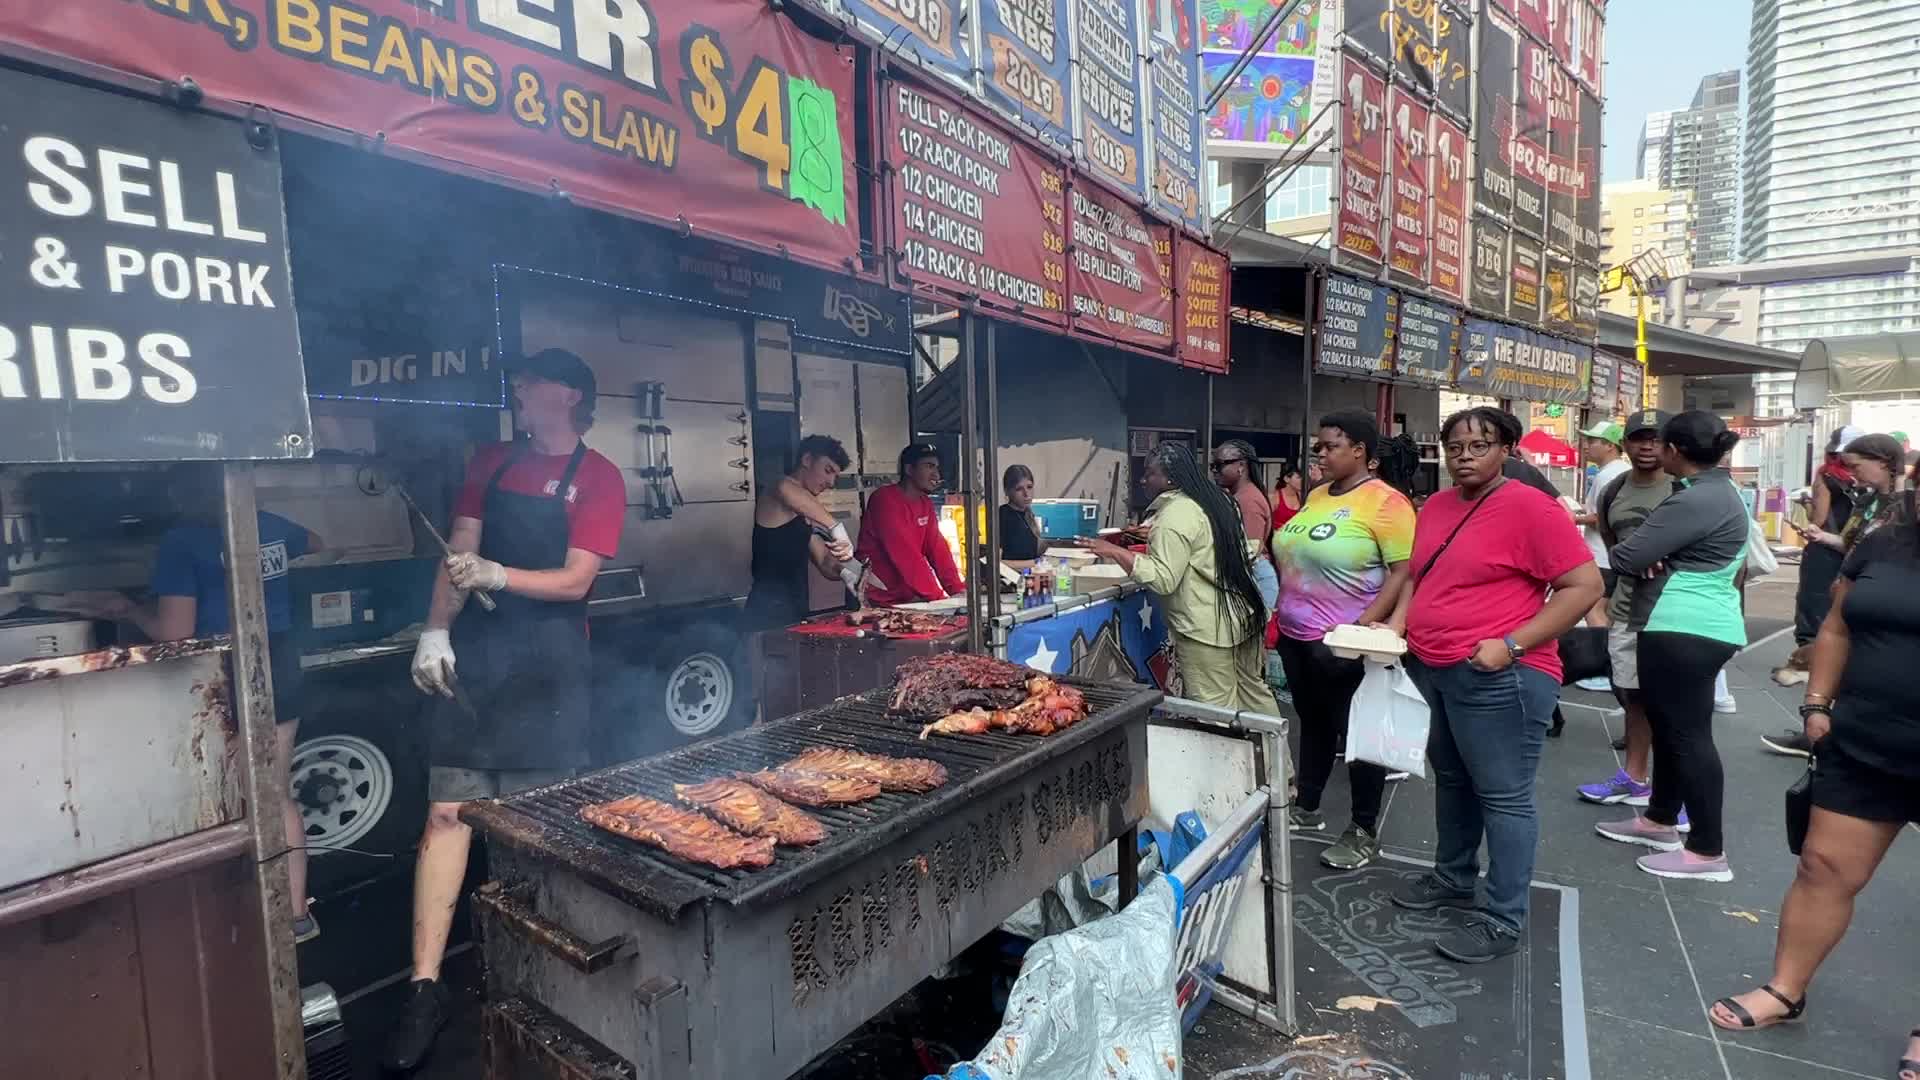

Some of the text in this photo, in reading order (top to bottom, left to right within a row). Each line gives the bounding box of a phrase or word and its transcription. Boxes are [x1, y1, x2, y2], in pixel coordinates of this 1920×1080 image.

[412, 0, 657, 89] ER
[276, 0, 497, 107] BEANS
[514, 72, 547, 125] &
[562, 88, 677, 168] SLAW
[1081, 67, 1134, 134] SAUCE
[899, 87, 1010, 169] FULL RACK PORK
[899, 127, 999, 195] 1/2 RACK PORK
[24, 136, 267, 244] SELL
[901, 164, 983, 222] 1/2 CHICKEN
[903, 202, 984, 255] 1/4 CHICKEN
[1073, 220, 1109, 253] BRISKET
[1397, 213, 1422, 235] RIBS
[30, 237, 276, 308] & PORK
[905, 239, 1044, 309] 1/2 RACK & 1/4 CHICKEN
[1080, 250, 1090, 273] LB
[1091, 255, 1122, 284] PULLED
[1123, 267, 1142, 294] PORK
[1191, 262, 1218, 279] TAKE
[1327, 279, 1341, 294] FULL
[1073, 295, 1098, 316] BEANS
[1185, 313, 1219, 329] SAUCE
[352, 353, 417, 387] DIG
[432, 349, 466, 377] IN
[1494, 336, 1514, 364] THE
